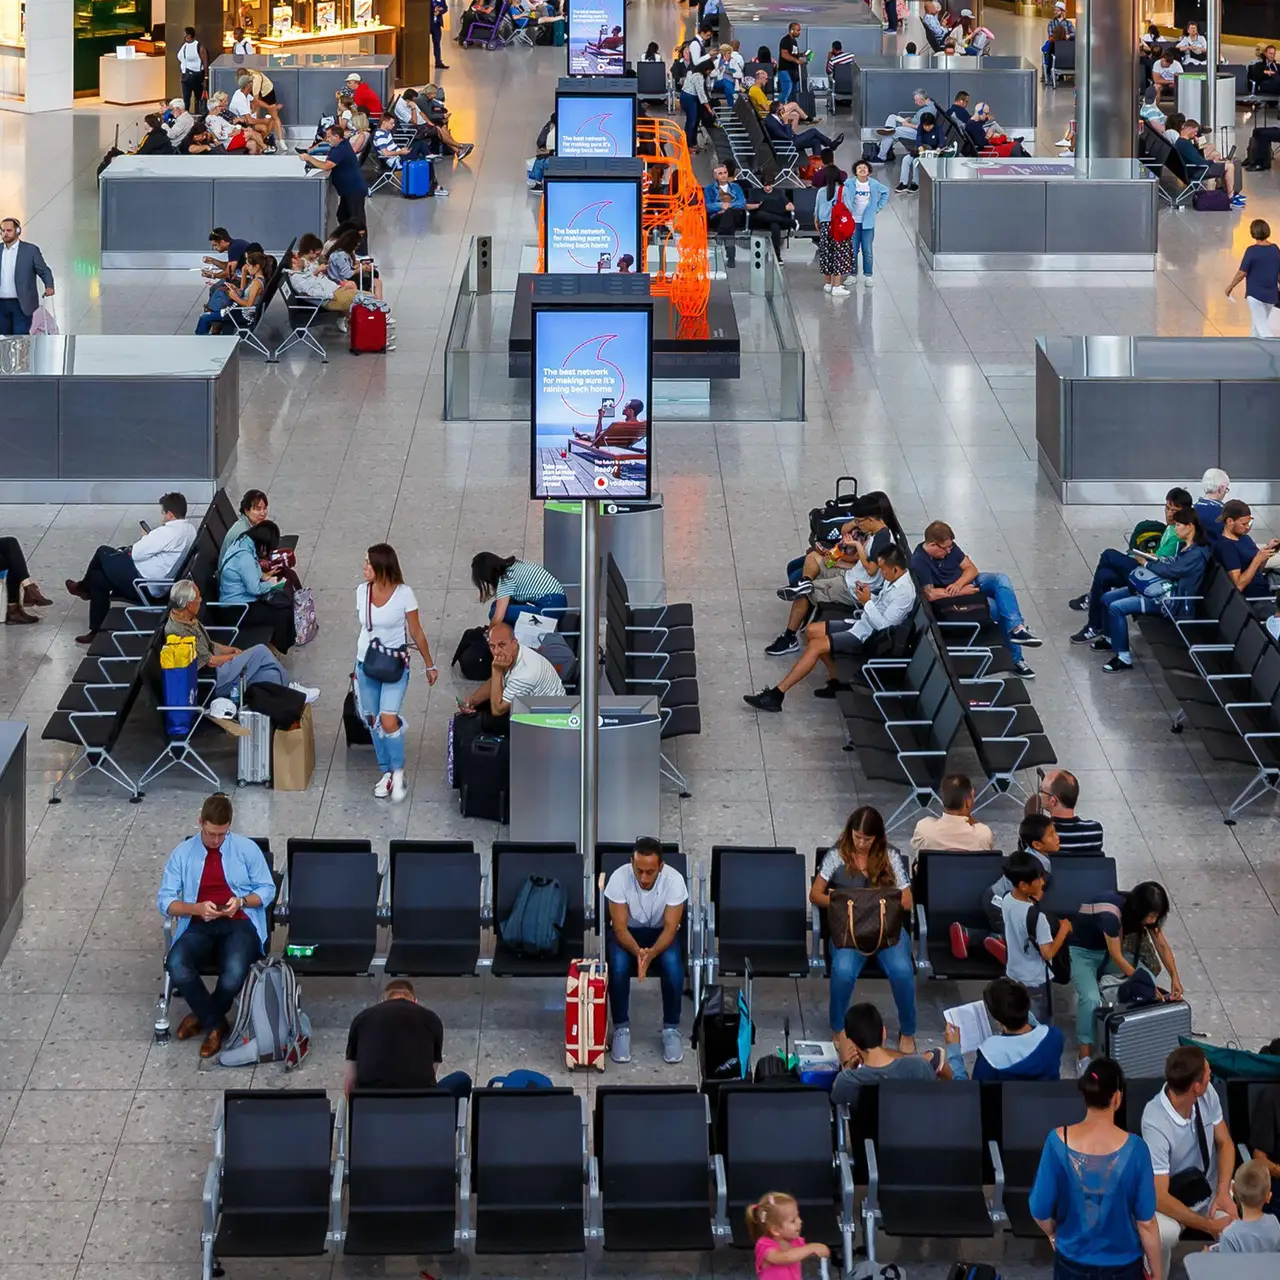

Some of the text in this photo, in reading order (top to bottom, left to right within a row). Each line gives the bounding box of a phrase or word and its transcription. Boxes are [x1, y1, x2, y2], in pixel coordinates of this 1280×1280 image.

[579, 227, 605, 235] network
[543, 367, 608, 376] The best network
[543, 376, 554, 384] for
[555, 376, 584, 386] making
[603, 376, 615, 384] it's
[543, 385, 613, 394] raining back home
[594, 465, 618, 474] Ready?
